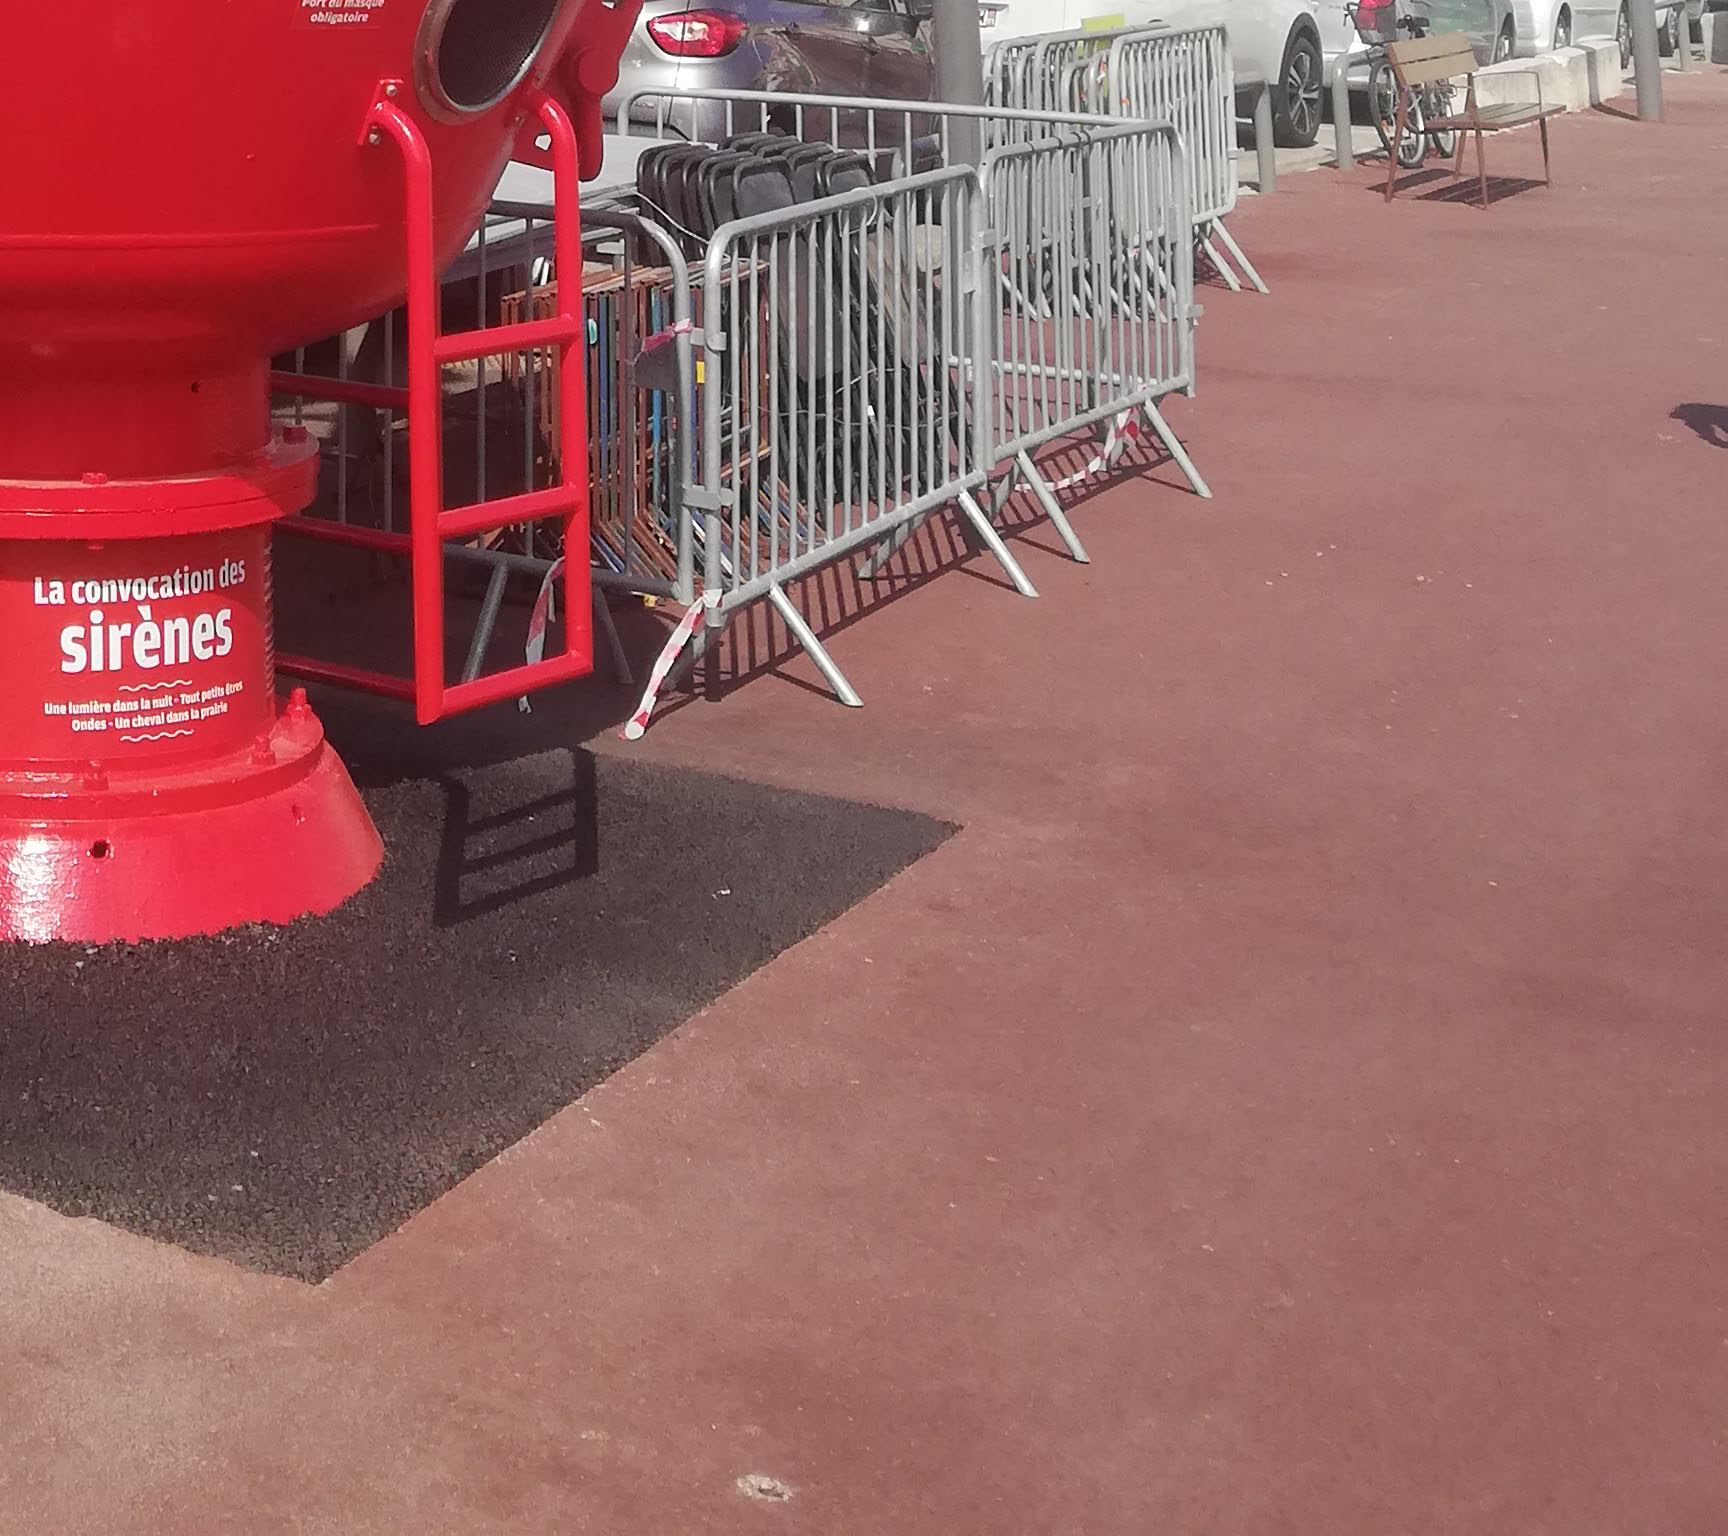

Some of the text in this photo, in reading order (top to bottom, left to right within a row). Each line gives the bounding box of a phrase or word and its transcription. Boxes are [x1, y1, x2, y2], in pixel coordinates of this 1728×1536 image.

[311, 11, 369, 25] obligatoire
[34, 557, 246, 605] La convocation des
[60, 604, 233, 673] sirènes
[44, 702, 67, 715] Une
[68, 699, 111, 715] lumière
[113, 699, 138, 713] dans
[140, 697, 151, 711] la
[152, 695, 174, 709] nuit
[180, 690, 200, 705] Tout
[201, 685, 225, 703] petits
[71, 701, 228, 732] Ondes Un cheval dans la prairie
